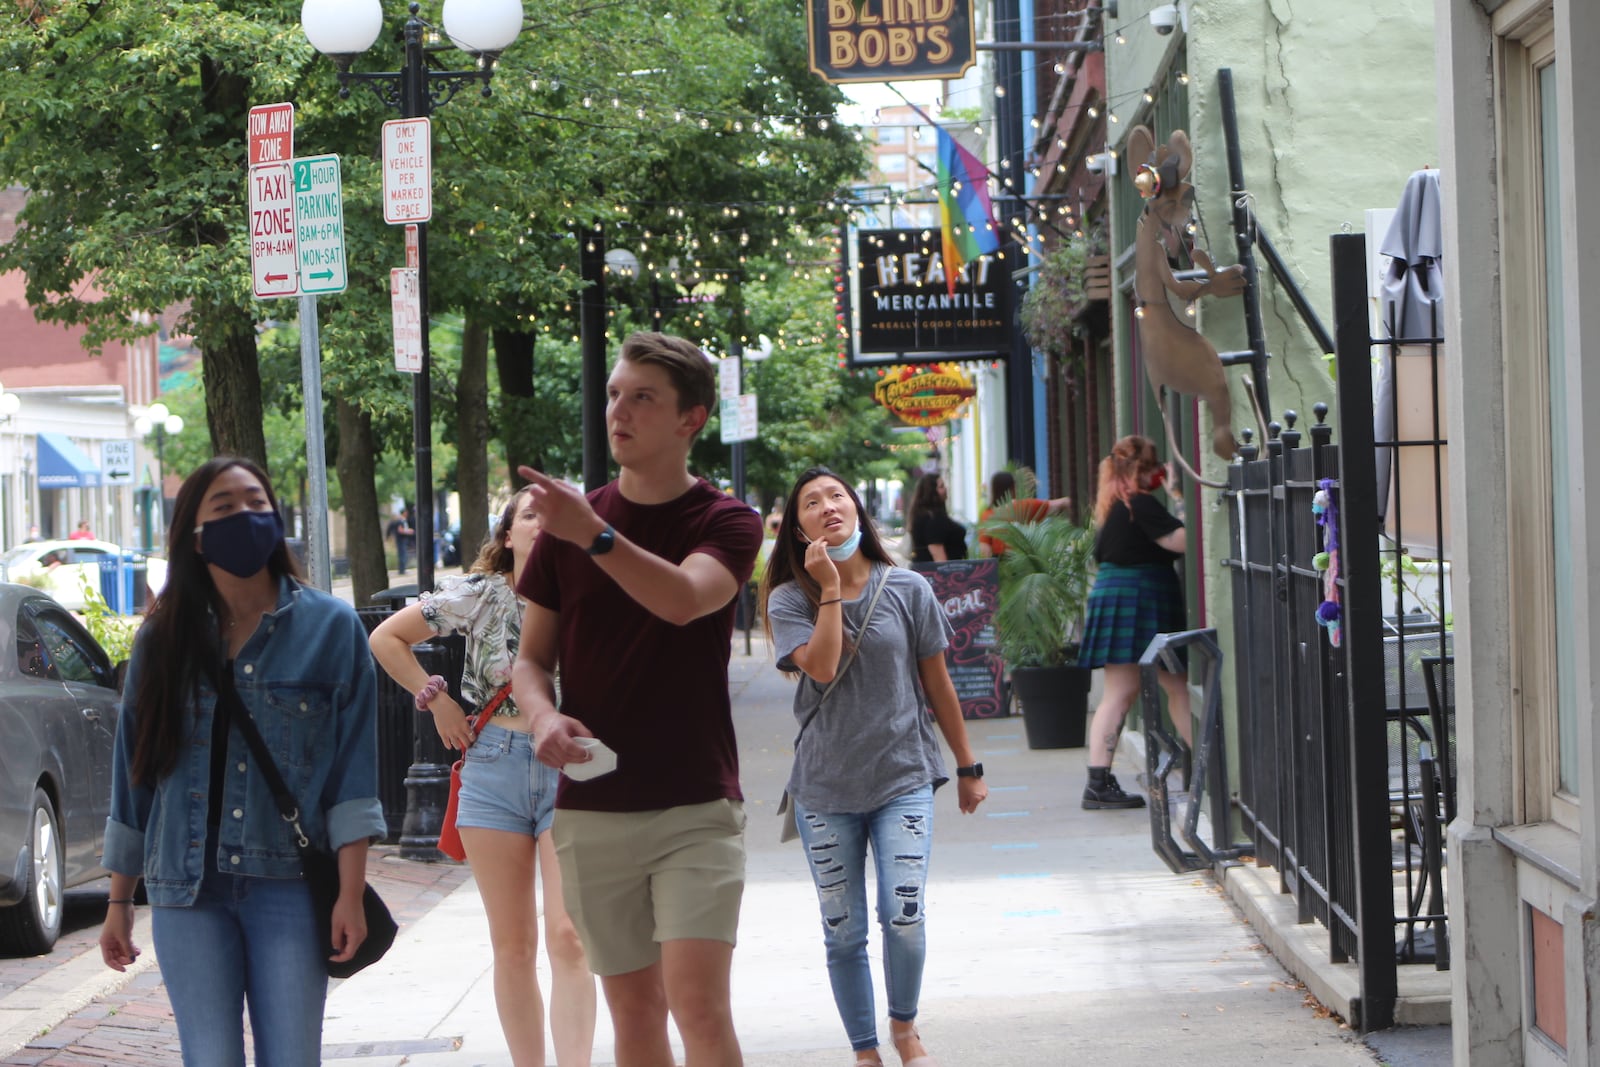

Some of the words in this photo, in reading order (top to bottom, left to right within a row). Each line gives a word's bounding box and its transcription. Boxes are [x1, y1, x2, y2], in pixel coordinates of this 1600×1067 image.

[827, 0, 954, 27] BLIND
[829, 25, 954, 68] BOB'S
[251, 113, 267, 136] TOW
[268, 109, 291, 133] AWAY
[395, 126, 416, 139] ONLY
[258, 138, 282, 162] ZONE
[398, 142, 415, 154] ONE
[389, 156, 424, 170] VEHICLE
[298, 165, 308, 189] 2
[312, 167, 335, 185] HOUR
[399, 173, 415, 185] PER
[256, 174, 287, 202] TAXI
[391, 188, 424, 201] MARKED
[298, 193, 338, 220] PARKING
[395, 203, 420, 216] SPACE
[254, 208, 292, 237] ZONE
[300, 223, 340, 243] 8AM-6PM
[255, 239, 293, 258] 8PM-4AM
[303, 247, 340, 266] MON-SAT
[877, 292, 995, 311] MERCANTILE
[922, 320, 952, 328] GOOD
[957, 319, 993, 328] GOODS
[106, 443, 129, 455] ONE
[107, 455, 130, 467] WAY
